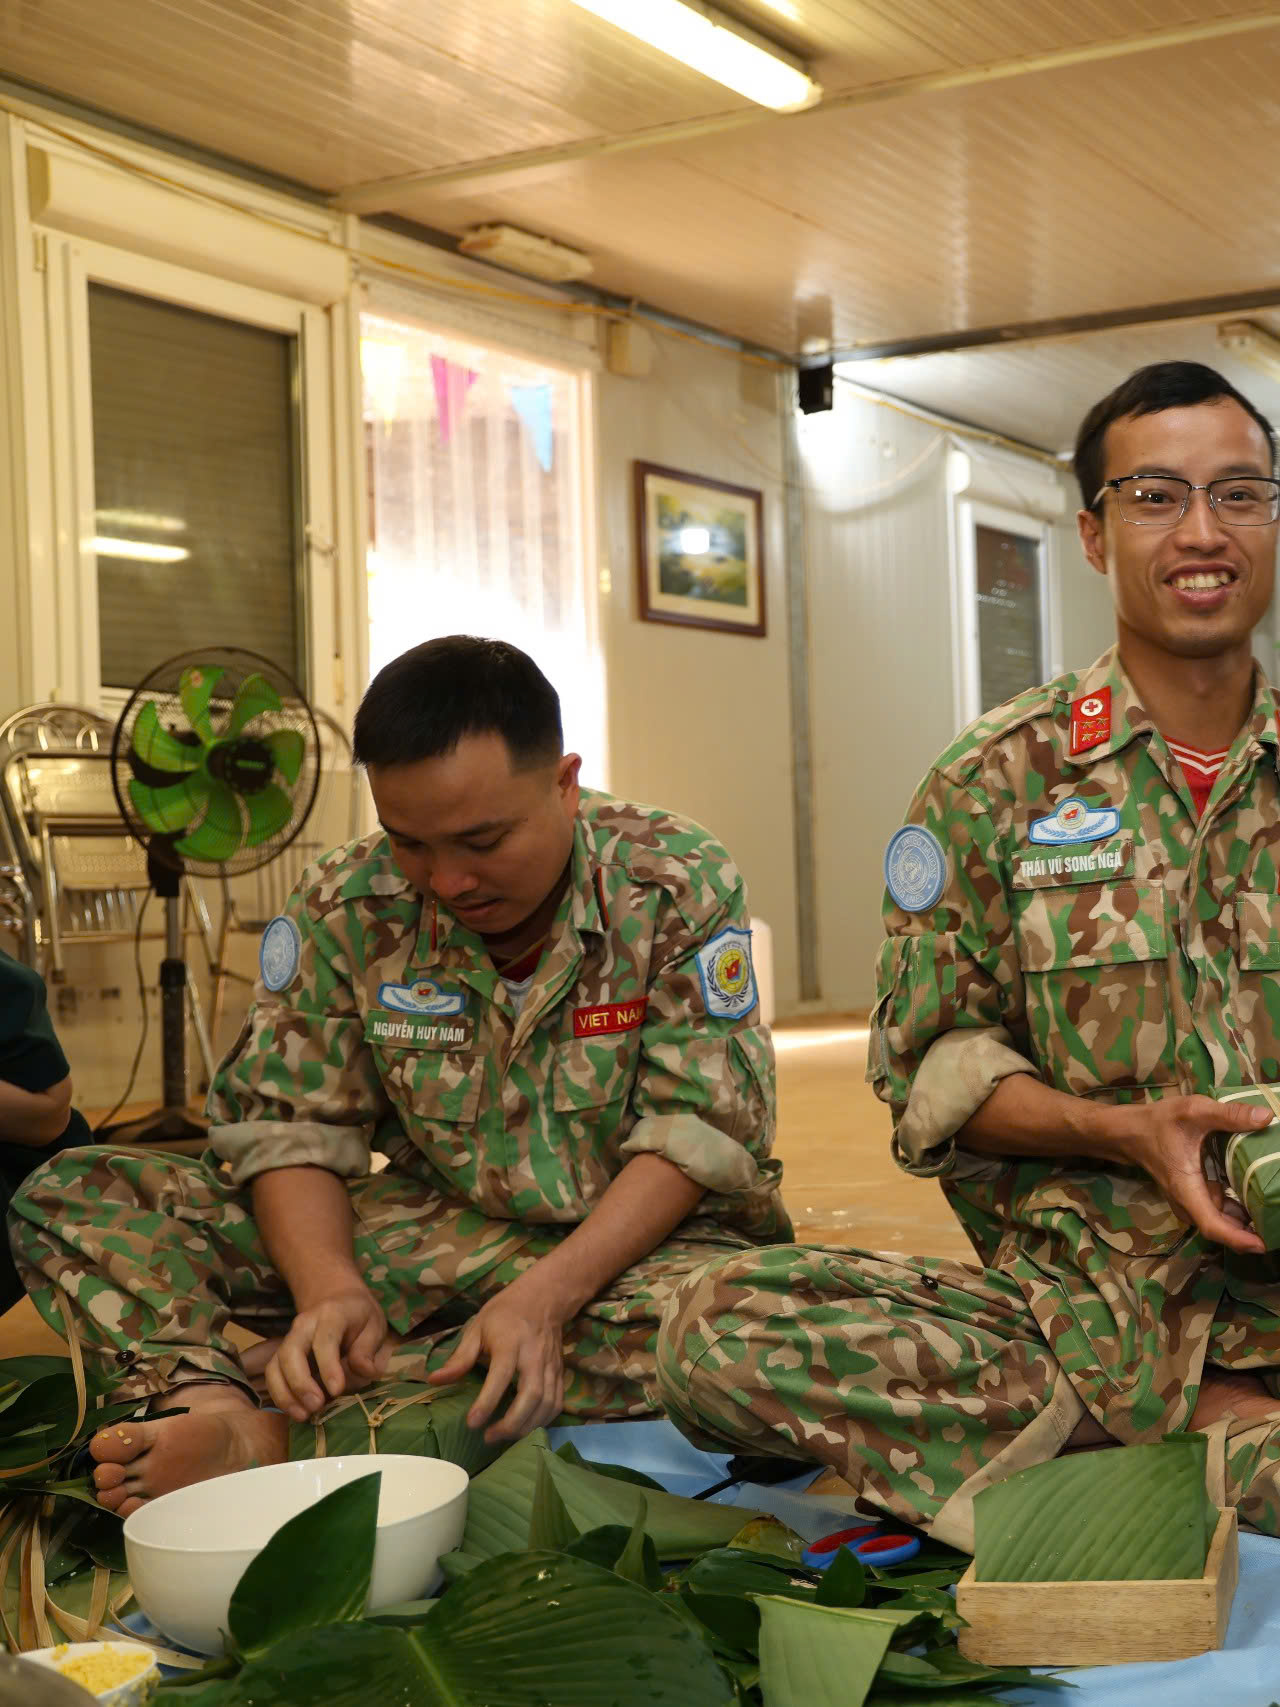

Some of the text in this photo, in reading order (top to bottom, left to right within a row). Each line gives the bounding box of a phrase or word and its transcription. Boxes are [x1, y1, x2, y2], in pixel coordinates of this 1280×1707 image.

[1020, 856, 1046, 878] THÁI
[1064, 855, 1096, 873] SONG
[578, 1012, 610, 1029] VIET
[416, 1025, 437, 1041] HUY
[439, 1027, 465, 1042] NAM
